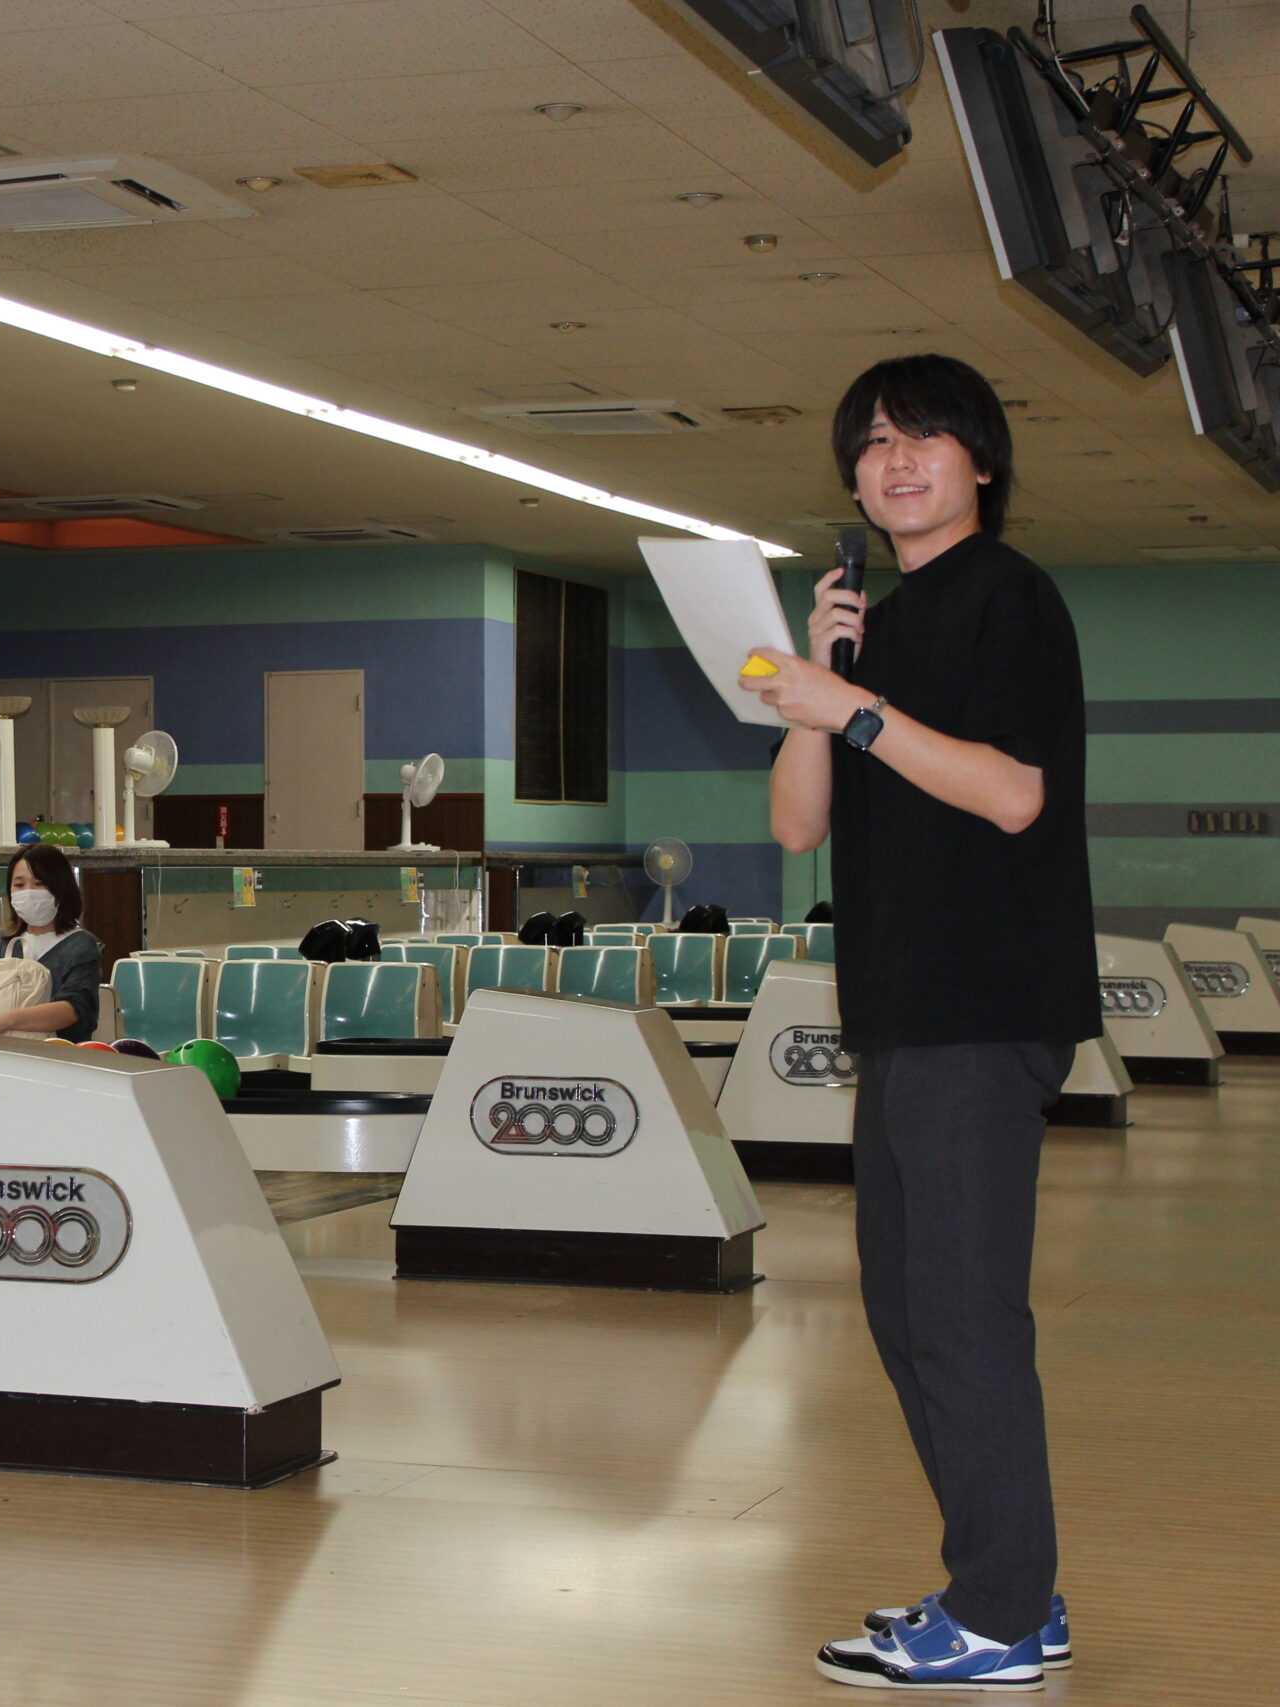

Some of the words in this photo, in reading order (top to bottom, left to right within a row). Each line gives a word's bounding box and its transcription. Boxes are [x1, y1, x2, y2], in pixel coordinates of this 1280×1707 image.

[793, 1030, 841, 1045] Bruns
[784, 1045, 858, 1079] 200
[501, 1081, 606, 1102] Brunswick
[488, 1100, 616, 1147] 2000
